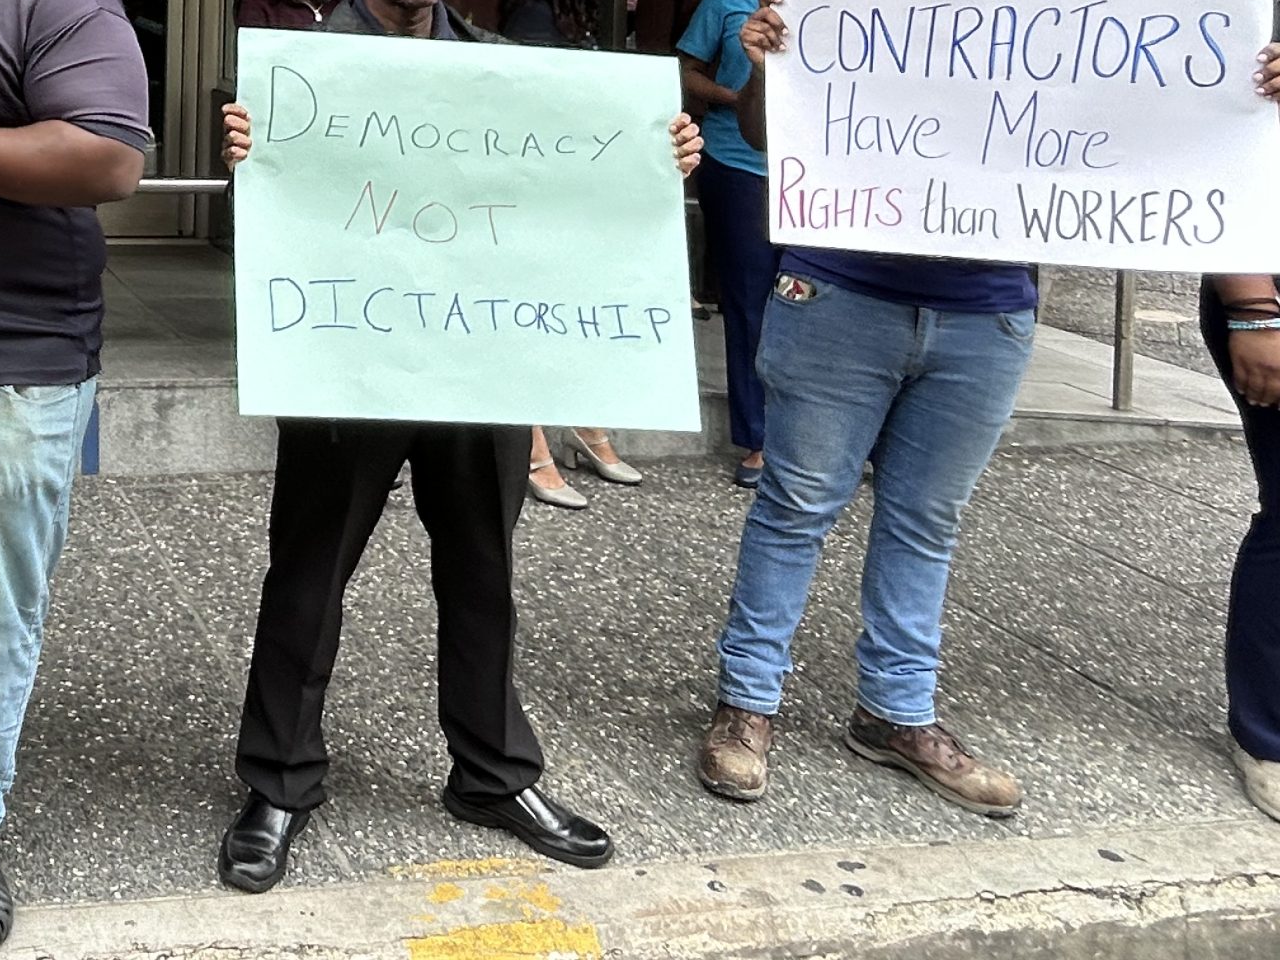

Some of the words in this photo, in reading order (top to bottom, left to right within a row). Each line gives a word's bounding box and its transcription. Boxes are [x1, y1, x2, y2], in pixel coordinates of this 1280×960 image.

[797, 0, 1231, 88] CONTRACTORS
[267, 65, 623, 161] DEMOCRACY
[825, 82, 952, 159] Have
[981, 90, 1120, 169] More
[344, 180, 517, 246] NOT
[778, 156, 903, 230] RIGHTS
[922, 178, 999, 239] than
[1017, 182, 1226, 246] WORKERS
[269, 277, 672, 344] DICTATORSHIP
